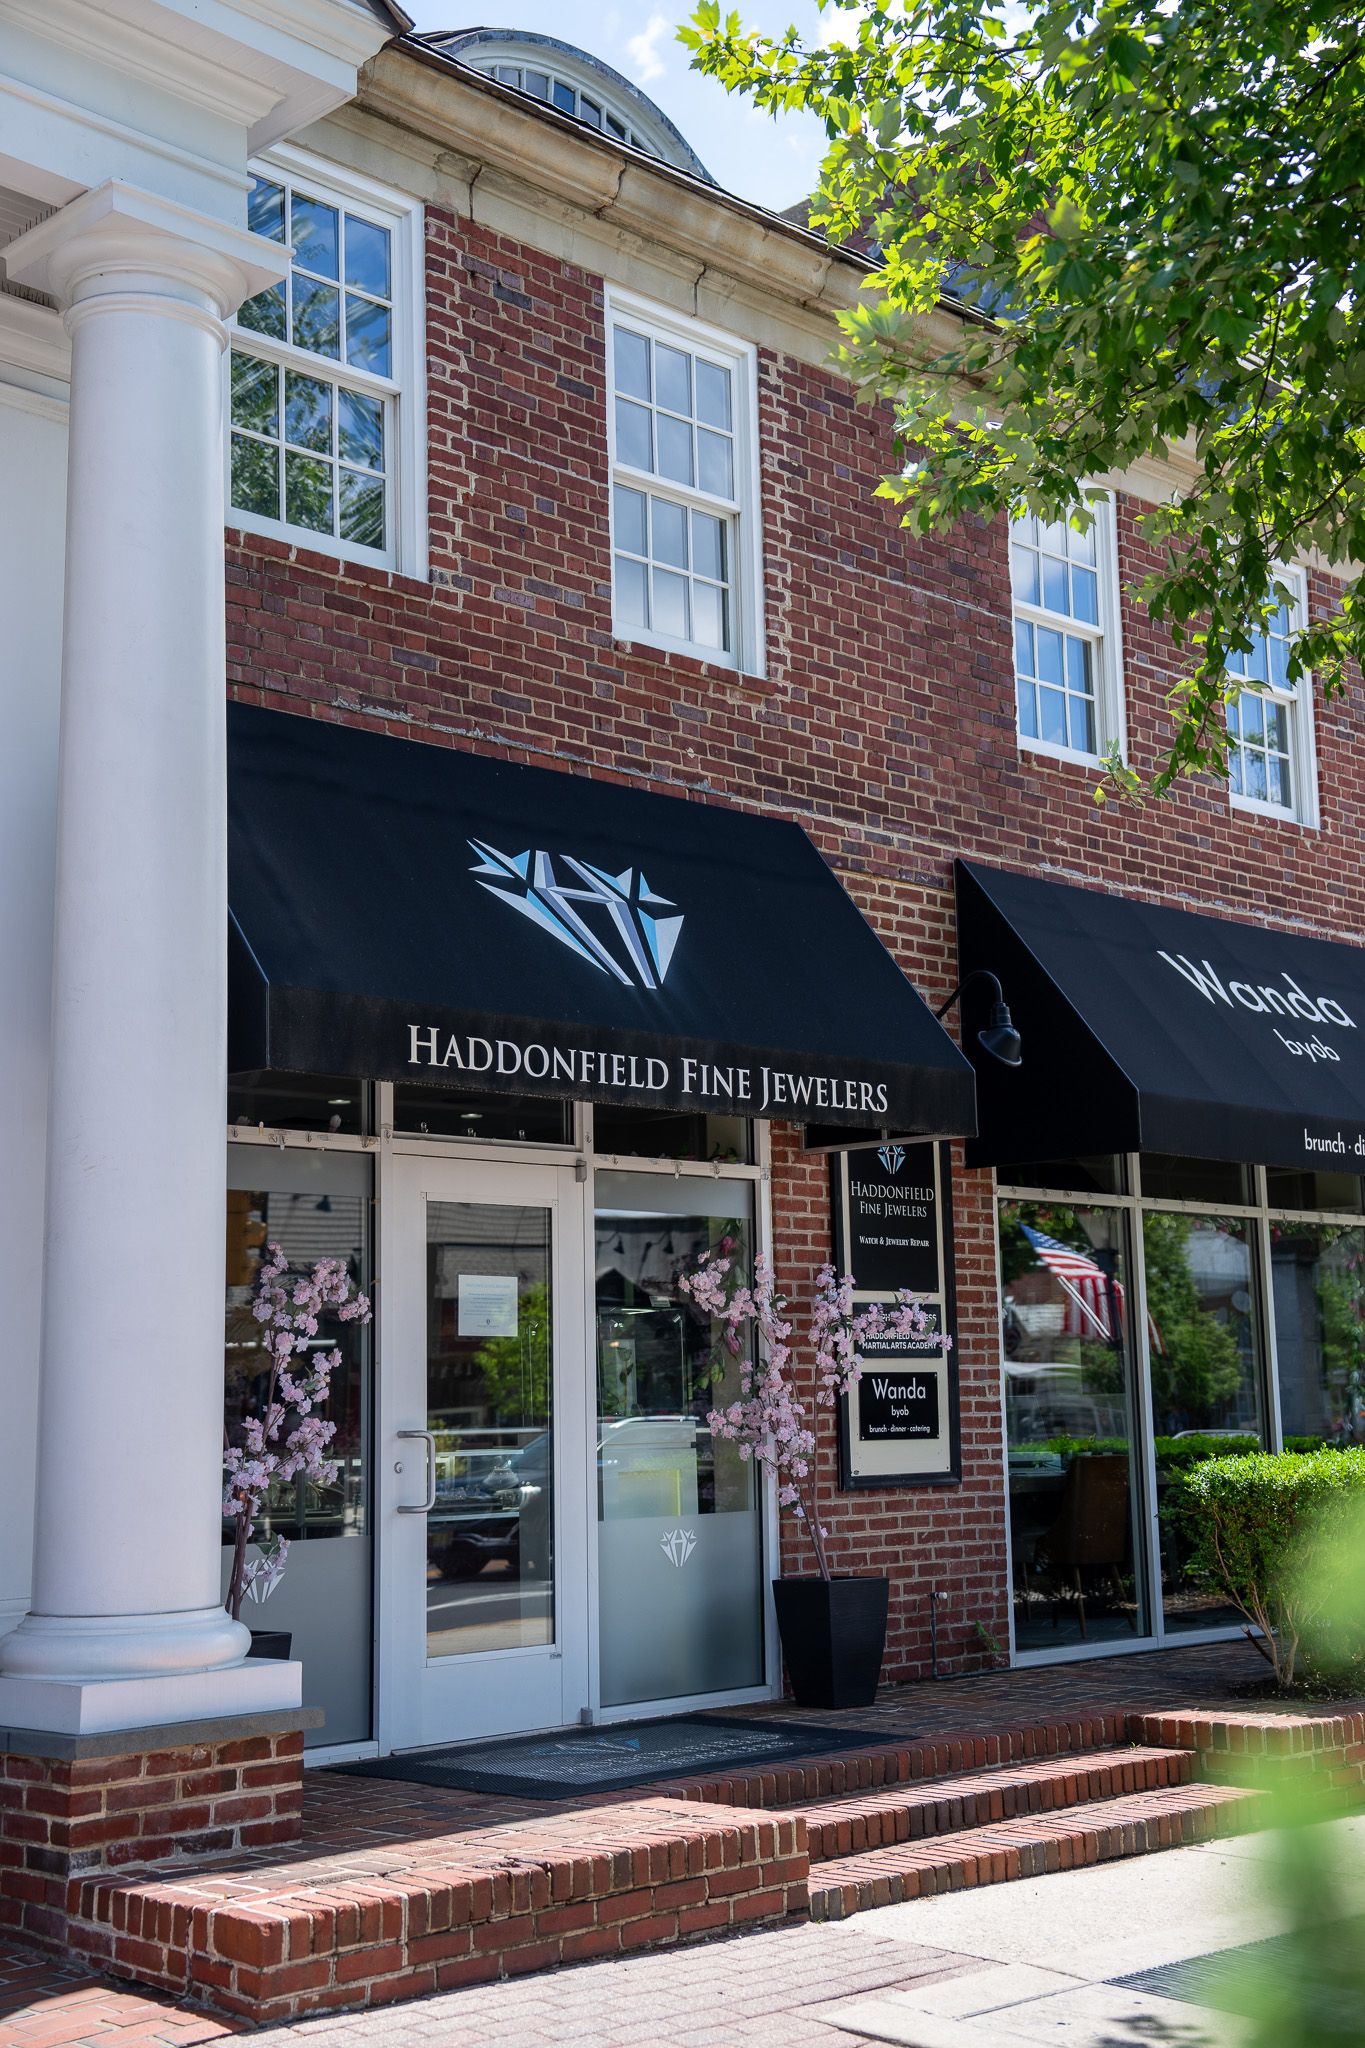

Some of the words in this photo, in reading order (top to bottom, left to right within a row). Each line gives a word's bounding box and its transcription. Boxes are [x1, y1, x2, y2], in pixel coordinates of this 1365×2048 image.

[1156, 950, 1358, 1029] Wanda
[1272, 1028, 1341, 1063] byob
[407, 1024, 670, 1090] HADDONFIELD
[681, 1057, 752, 1100] FINE
[760, 1066, 889, 1113] JEWELERS
[1304, 1128, 1346, 1154] brunch
[850, 1180, 934, 1201] HADDONFIELD
[860, 1201, 881, 1215] FINE
[884, 1202, 927, 1218] JEWELERS
[859, 1235, 879, 1245] WATCH
[885, 1236, 909, 1247] JEWELRY
[910, 1238, 930, 1247] REPAIR
[862, 1341, 891, 1350] MARTIAL
[891, 1341, 907, 1350] ARTS
[907, 1341, 937, 1350] ACADEMY
[872, 1377, 926, 1400] Wanda
[891, 1404, 909, 1418] byob
[869, 1424, 888, 1433] brunch
[890, 1424, 907, 1433] dinner
[909, 1424, 931, 1434] catering
